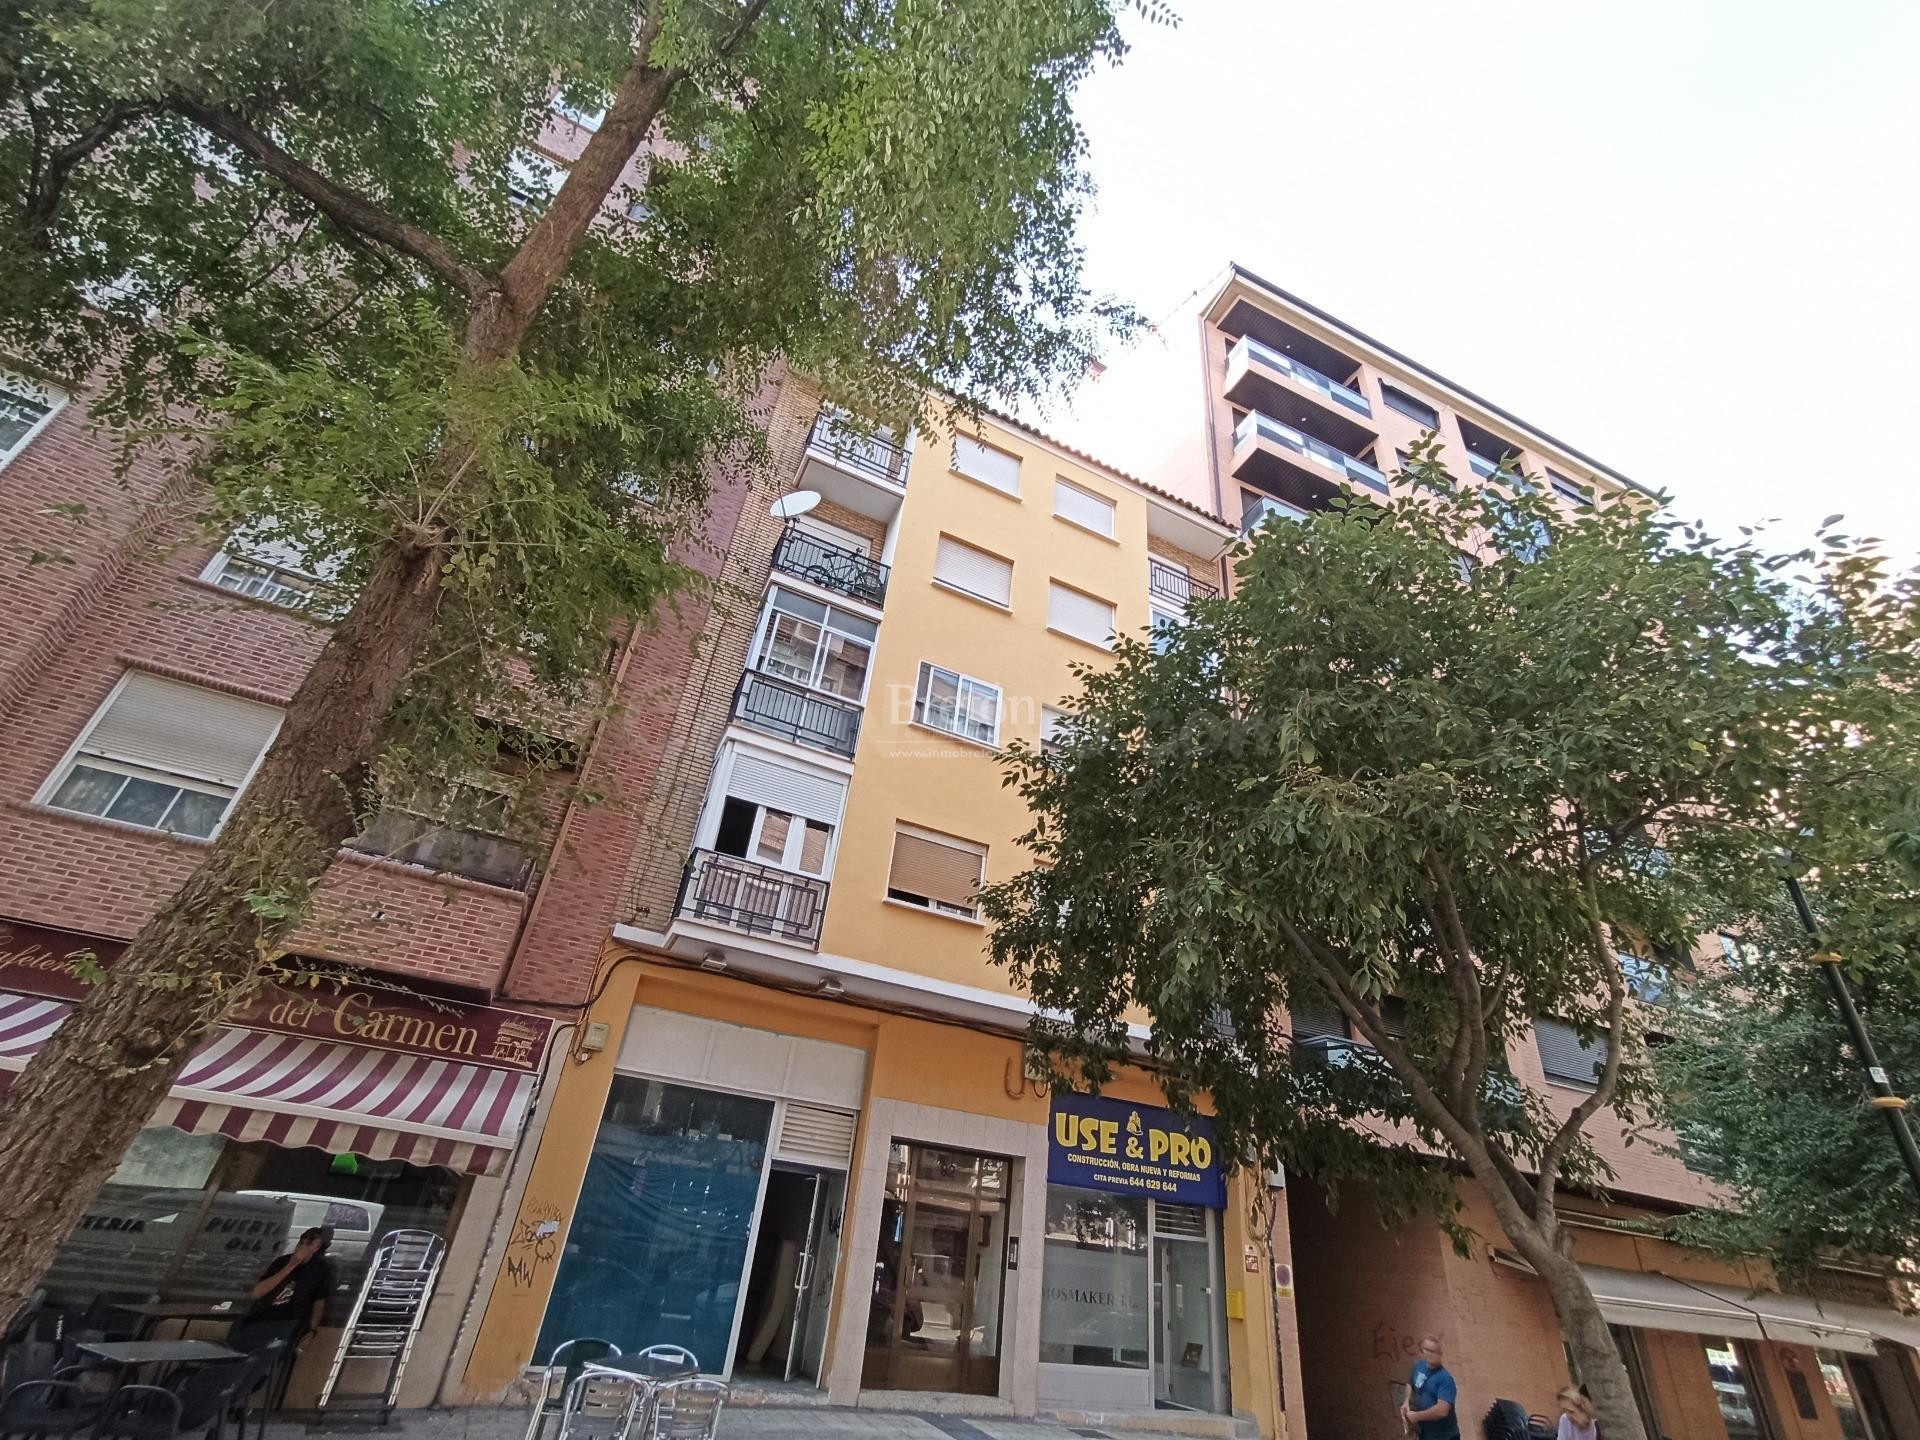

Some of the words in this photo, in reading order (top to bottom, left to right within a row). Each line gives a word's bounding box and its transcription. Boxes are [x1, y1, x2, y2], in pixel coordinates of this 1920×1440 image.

[269, 998, 318, 1028] del
[333, 992, 479, 1056] Carmen
[1056, 1112, 1118, 1154] USE
[1125, 1136, 1144, 1159] &
[1149, 1128, 1212, 1169] PRO
[1067, 1153, 1121, 1171] CONSTRUCCIÓN,
[1121, 1162, 1140, 1173] OBRA
[1140, 1165, 1162, 1177] NUEVA
[1162, 1168, 1168, 1177] Y
[1168, 1169, 1201, 1182] REFORMAS
[1093, 1173, 1108, 1182] CITA
[1107, 1176, 1129, 1186] PREVIA
[1129, 1176, 1145, 1188] 644
[1146, 1179, 1161, 1190] 629
[1162, 1181, 1178, 1193] 644
